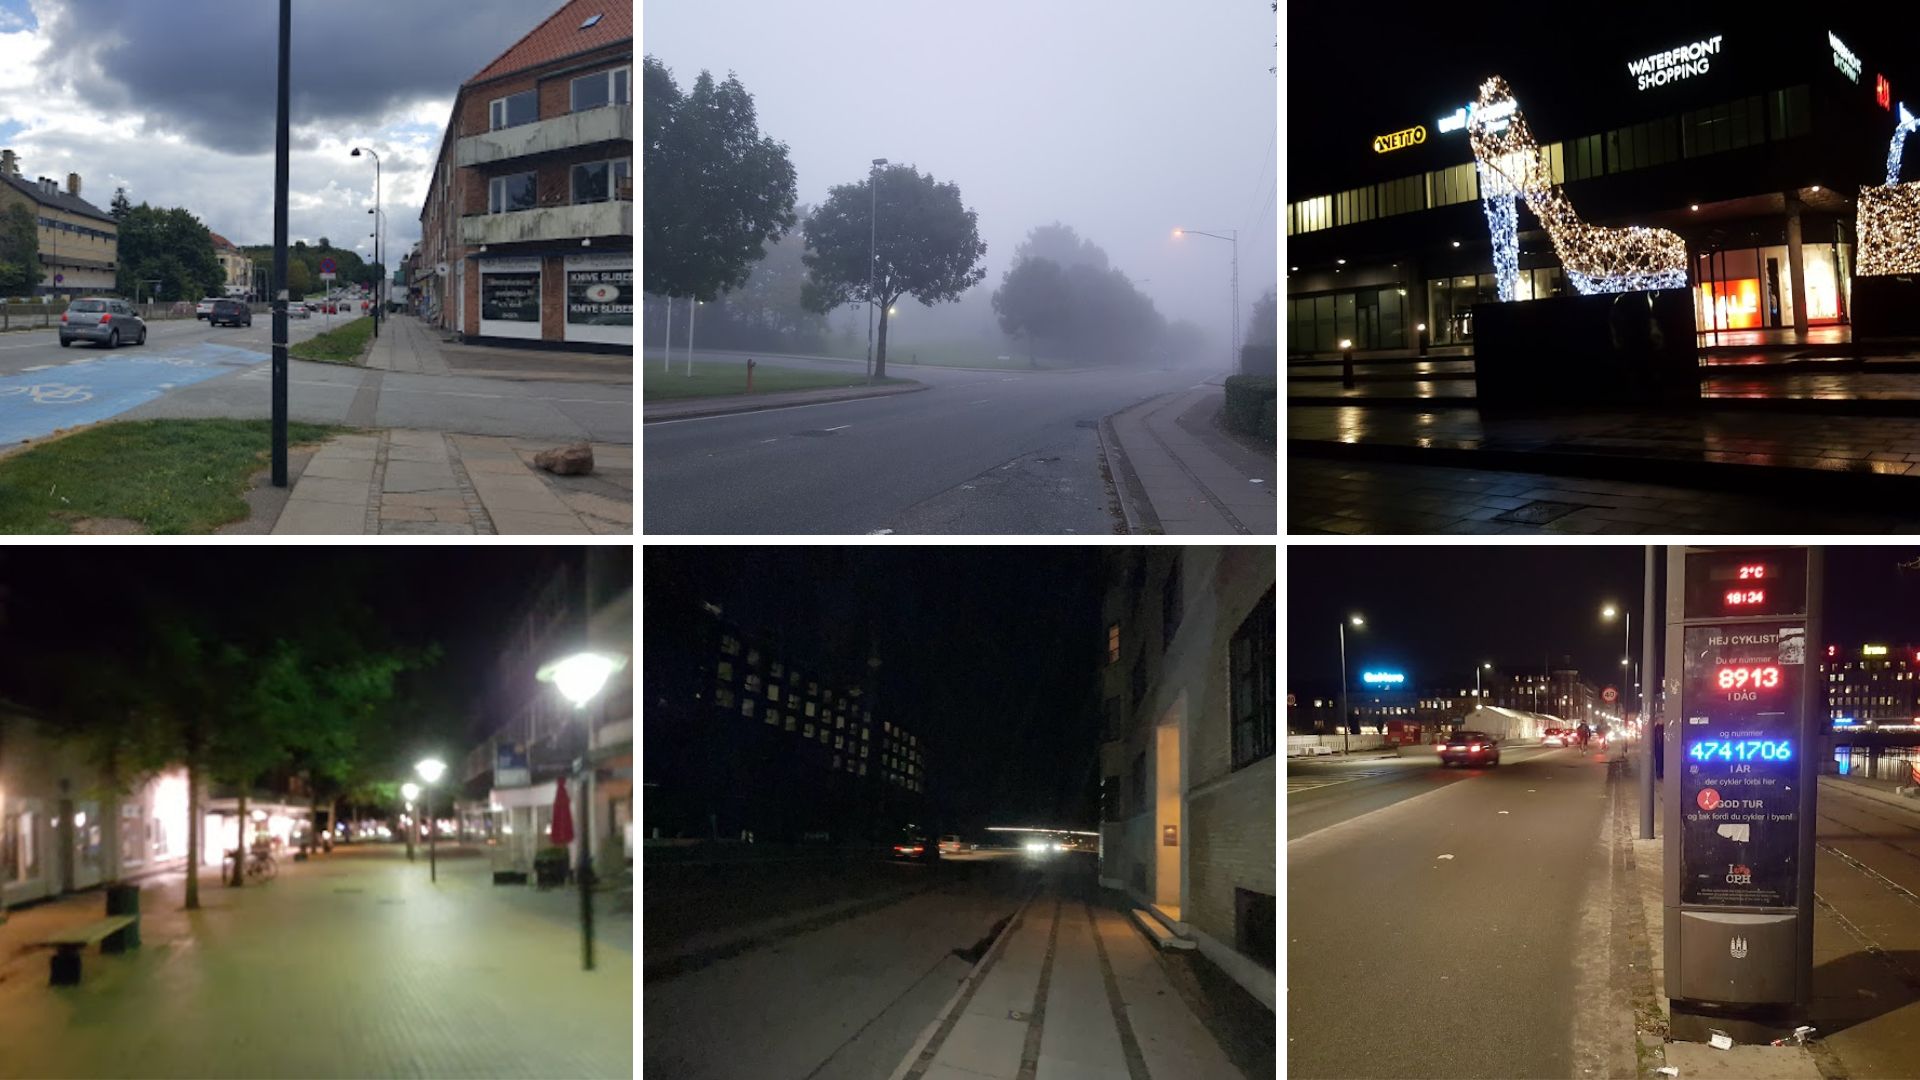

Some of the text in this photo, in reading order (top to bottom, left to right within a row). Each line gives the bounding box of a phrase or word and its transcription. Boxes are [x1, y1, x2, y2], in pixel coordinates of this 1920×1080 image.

[1628, 35, 1723, 78] WATERFRONT
[1637, 58, 1710, 91] SHOPPING
[1375, 125, 1427, 153] NETTO
[1739, 566, 1764, 579] 2°C
[1726, 591, 1764, 604] 18:34
[1708, 634, 1779, 646] HEJ CYKLIST!
[1715, 656, 1727, 665] Du
[1738, 656, 1771, 664] nummer
[1718, 667, 1779, 689] 8913
[1727, 692, 1731, 701] I
[1689, 740, 1791, 760] 4741706
[1719, 778, 1741, 786] cykler
[1717, 800, 1763, 809] GOD TUR
[1712, 812, 1729, 820] fordi
[1730, 812, 1741, 820] du
[1742, 812, 1765, 821] cykler
[1728, 864, 1734, 874] I
[1726, 874, 1751, 884] CPH
